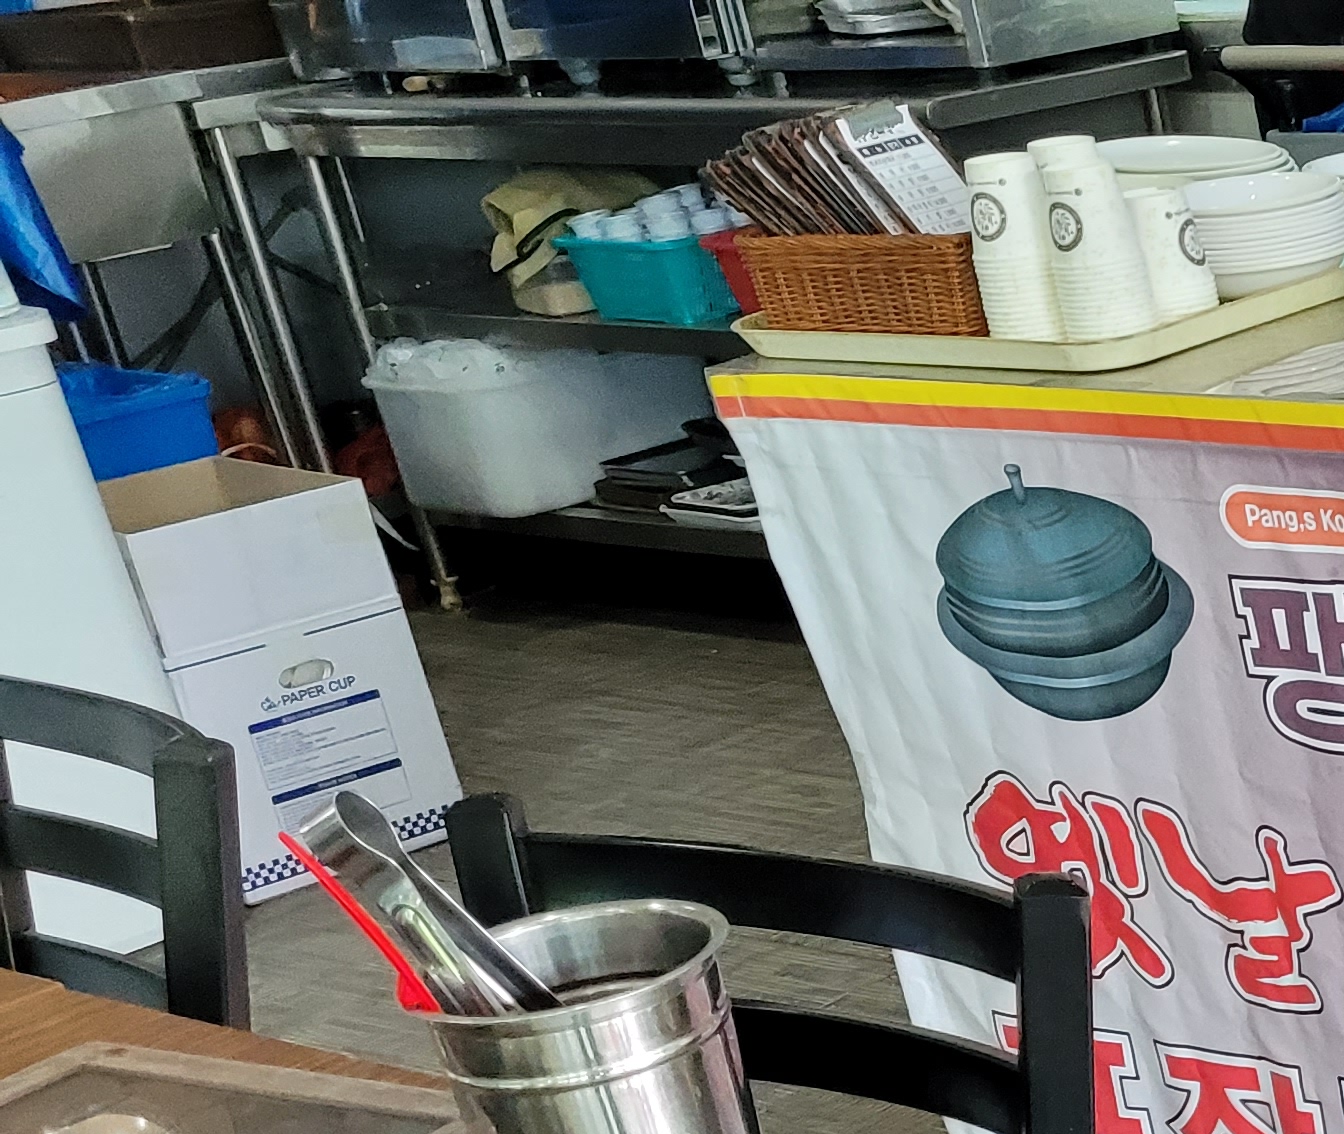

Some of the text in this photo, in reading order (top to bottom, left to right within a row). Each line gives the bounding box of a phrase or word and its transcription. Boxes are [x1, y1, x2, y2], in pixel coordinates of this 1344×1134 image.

[1244, 502, 1317, 534] Pang,s
[281, 685, 326, 706] PAPER
[328, 675, 356, 692] CUP
[964, 770, 1343, 1014] 옛날
